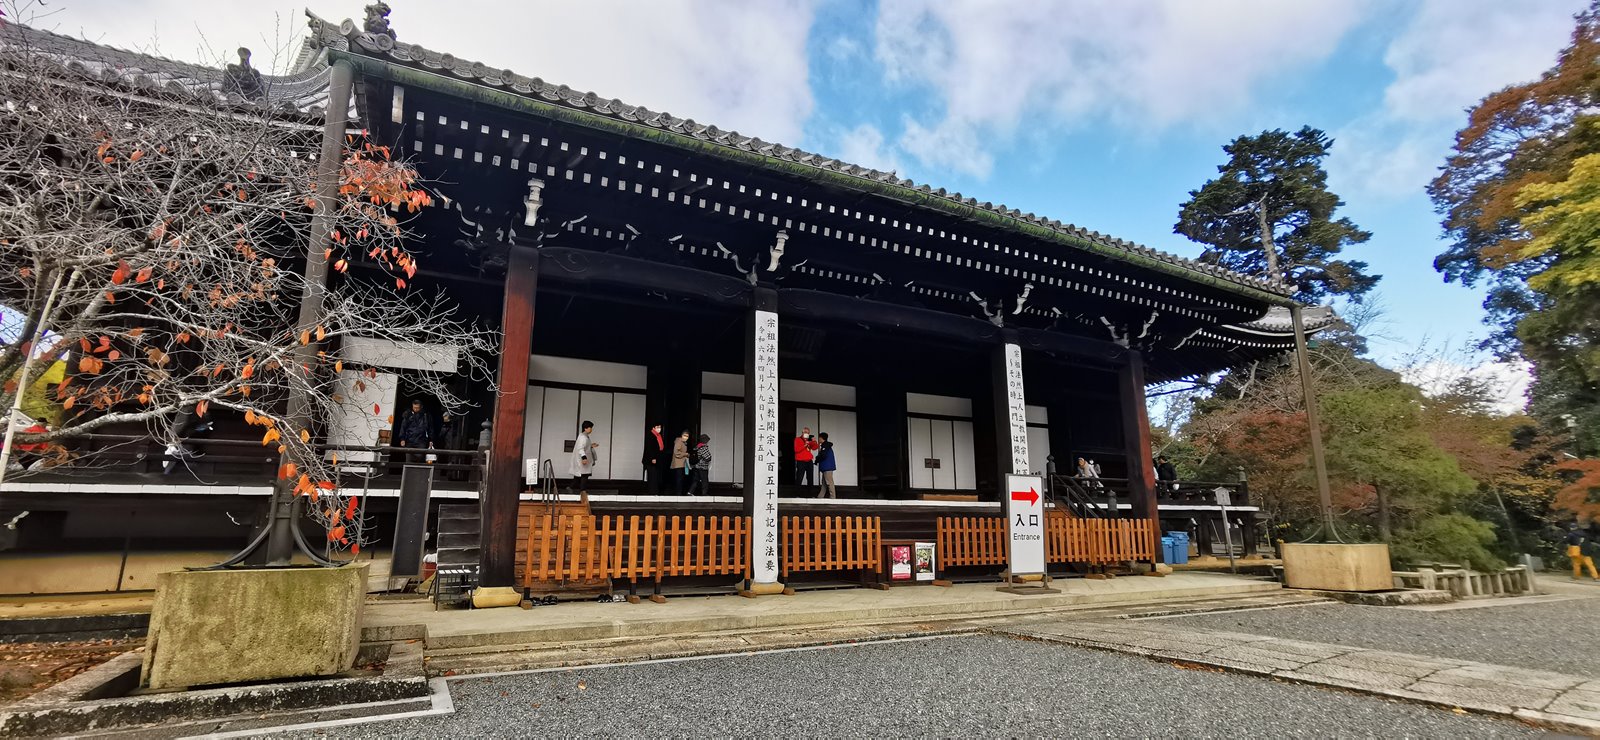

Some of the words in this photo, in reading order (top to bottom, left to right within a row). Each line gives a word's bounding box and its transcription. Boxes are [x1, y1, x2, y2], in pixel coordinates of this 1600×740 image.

[765, 317, 776, 571] 宗祖法然上人立教開宗八百五十年記念法要
[1015, 513, 1039, 527] 入口
[1013, 532, 1041, 541] Entrance
